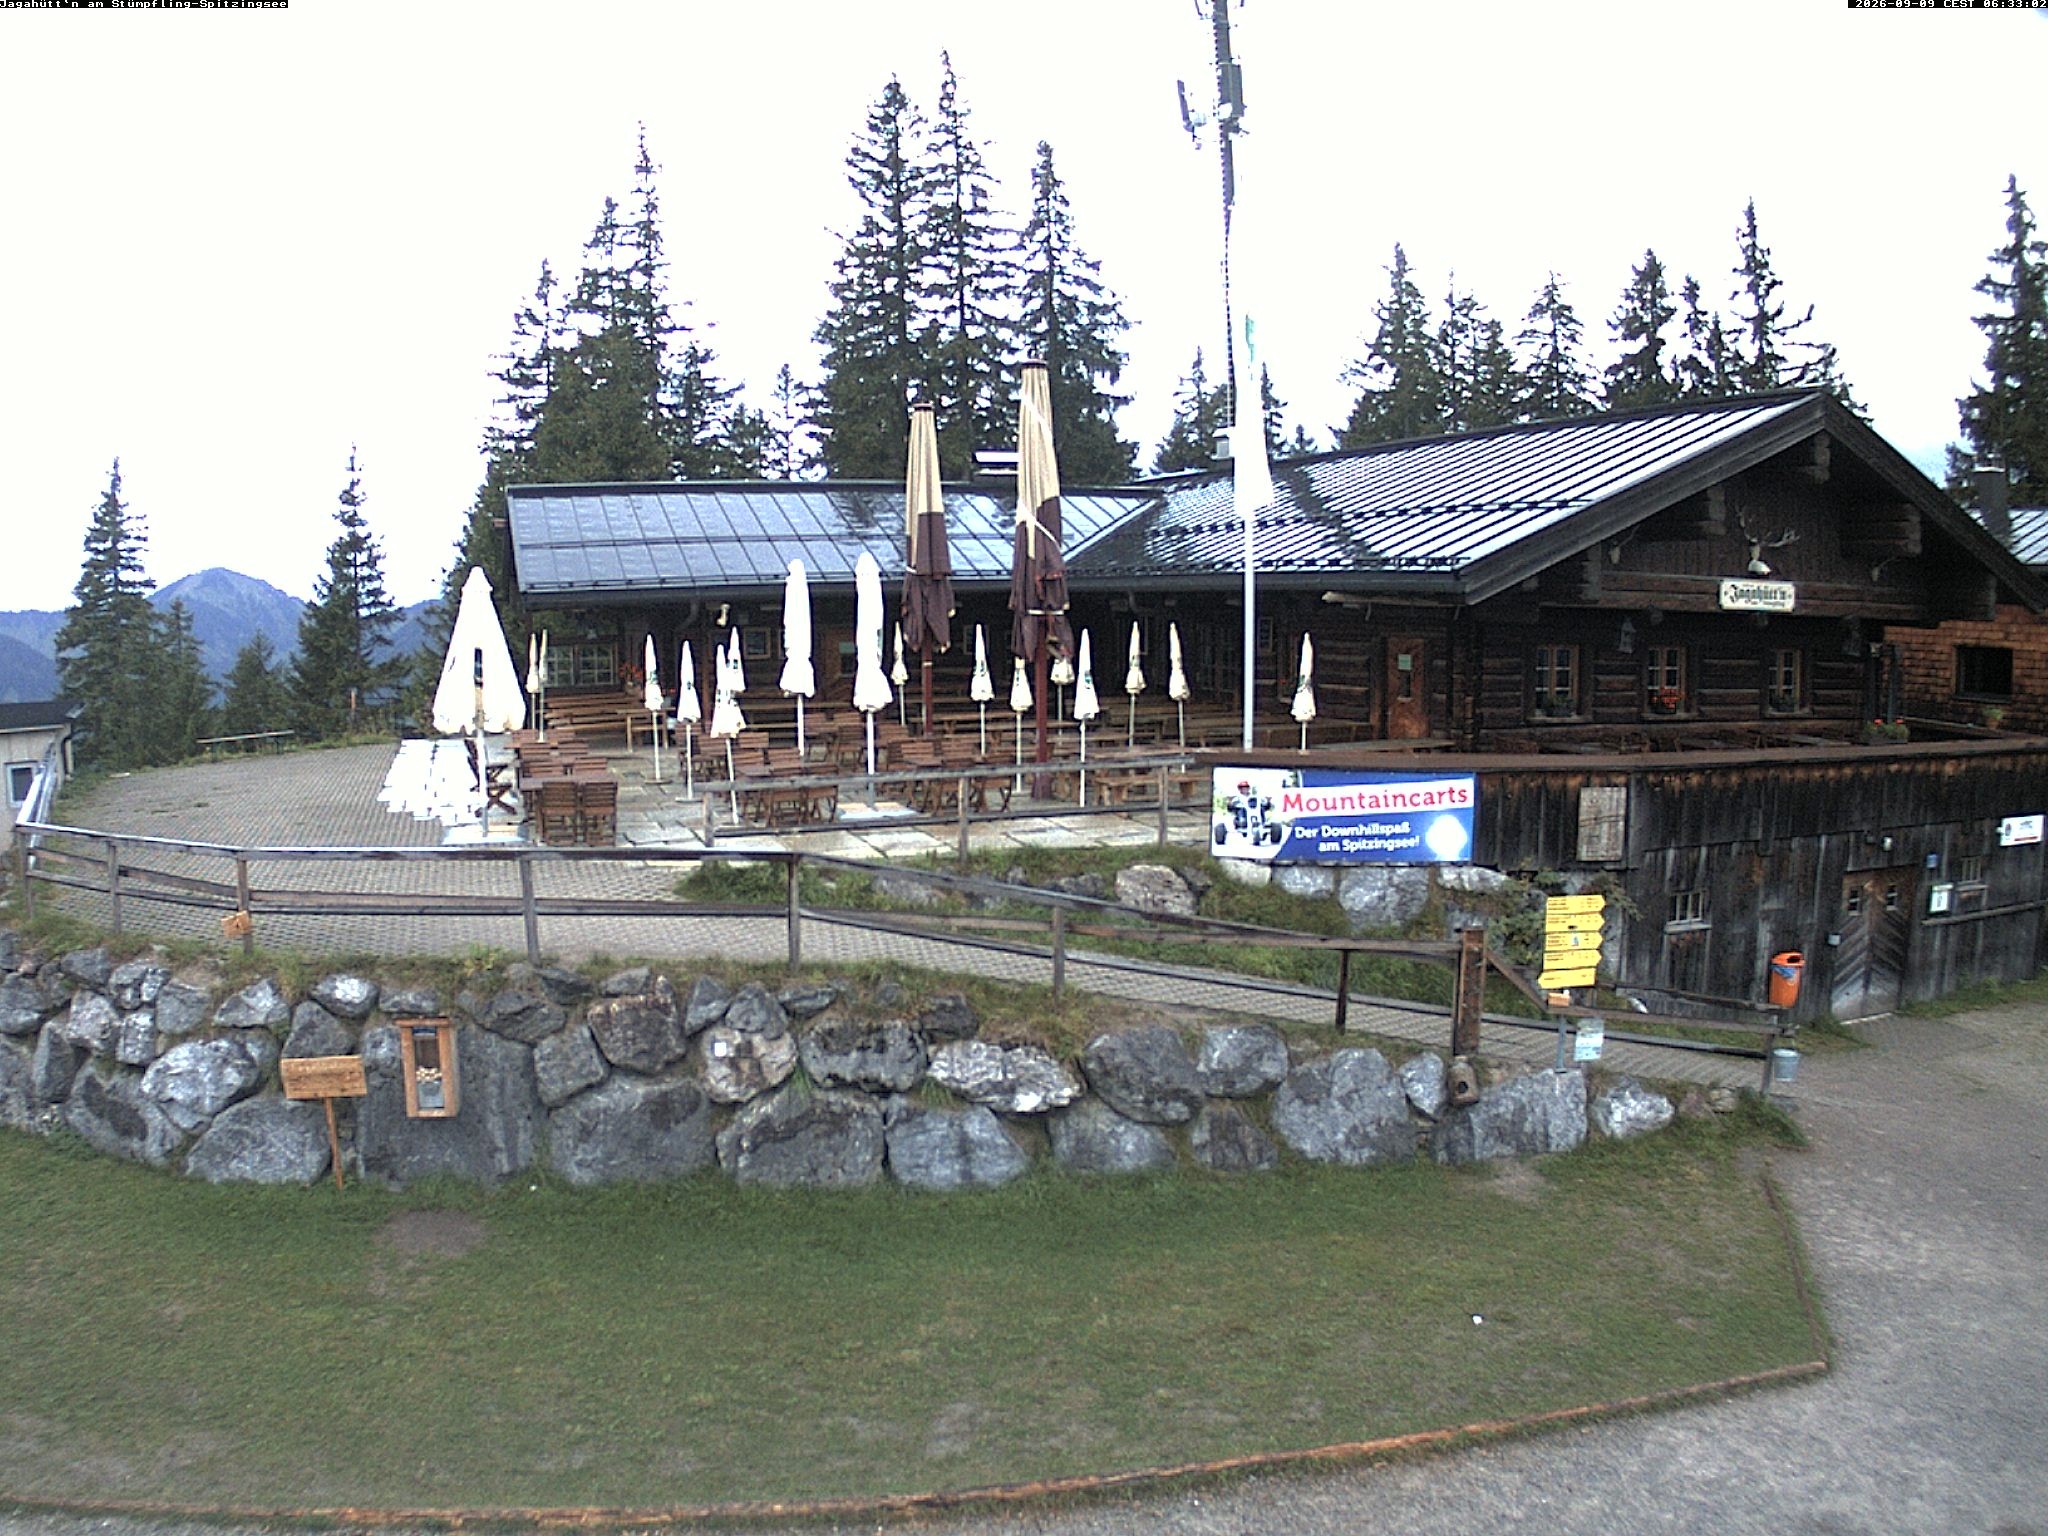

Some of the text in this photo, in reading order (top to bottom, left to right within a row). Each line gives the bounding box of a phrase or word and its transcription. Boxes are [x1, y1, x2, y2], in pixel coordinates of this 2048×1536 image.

[1282, 786, 1468, 813] Mountaincarts
[1295, 821, 1411, 839] Der Downhillspaß
[1318, 841, 1341, 852] am
